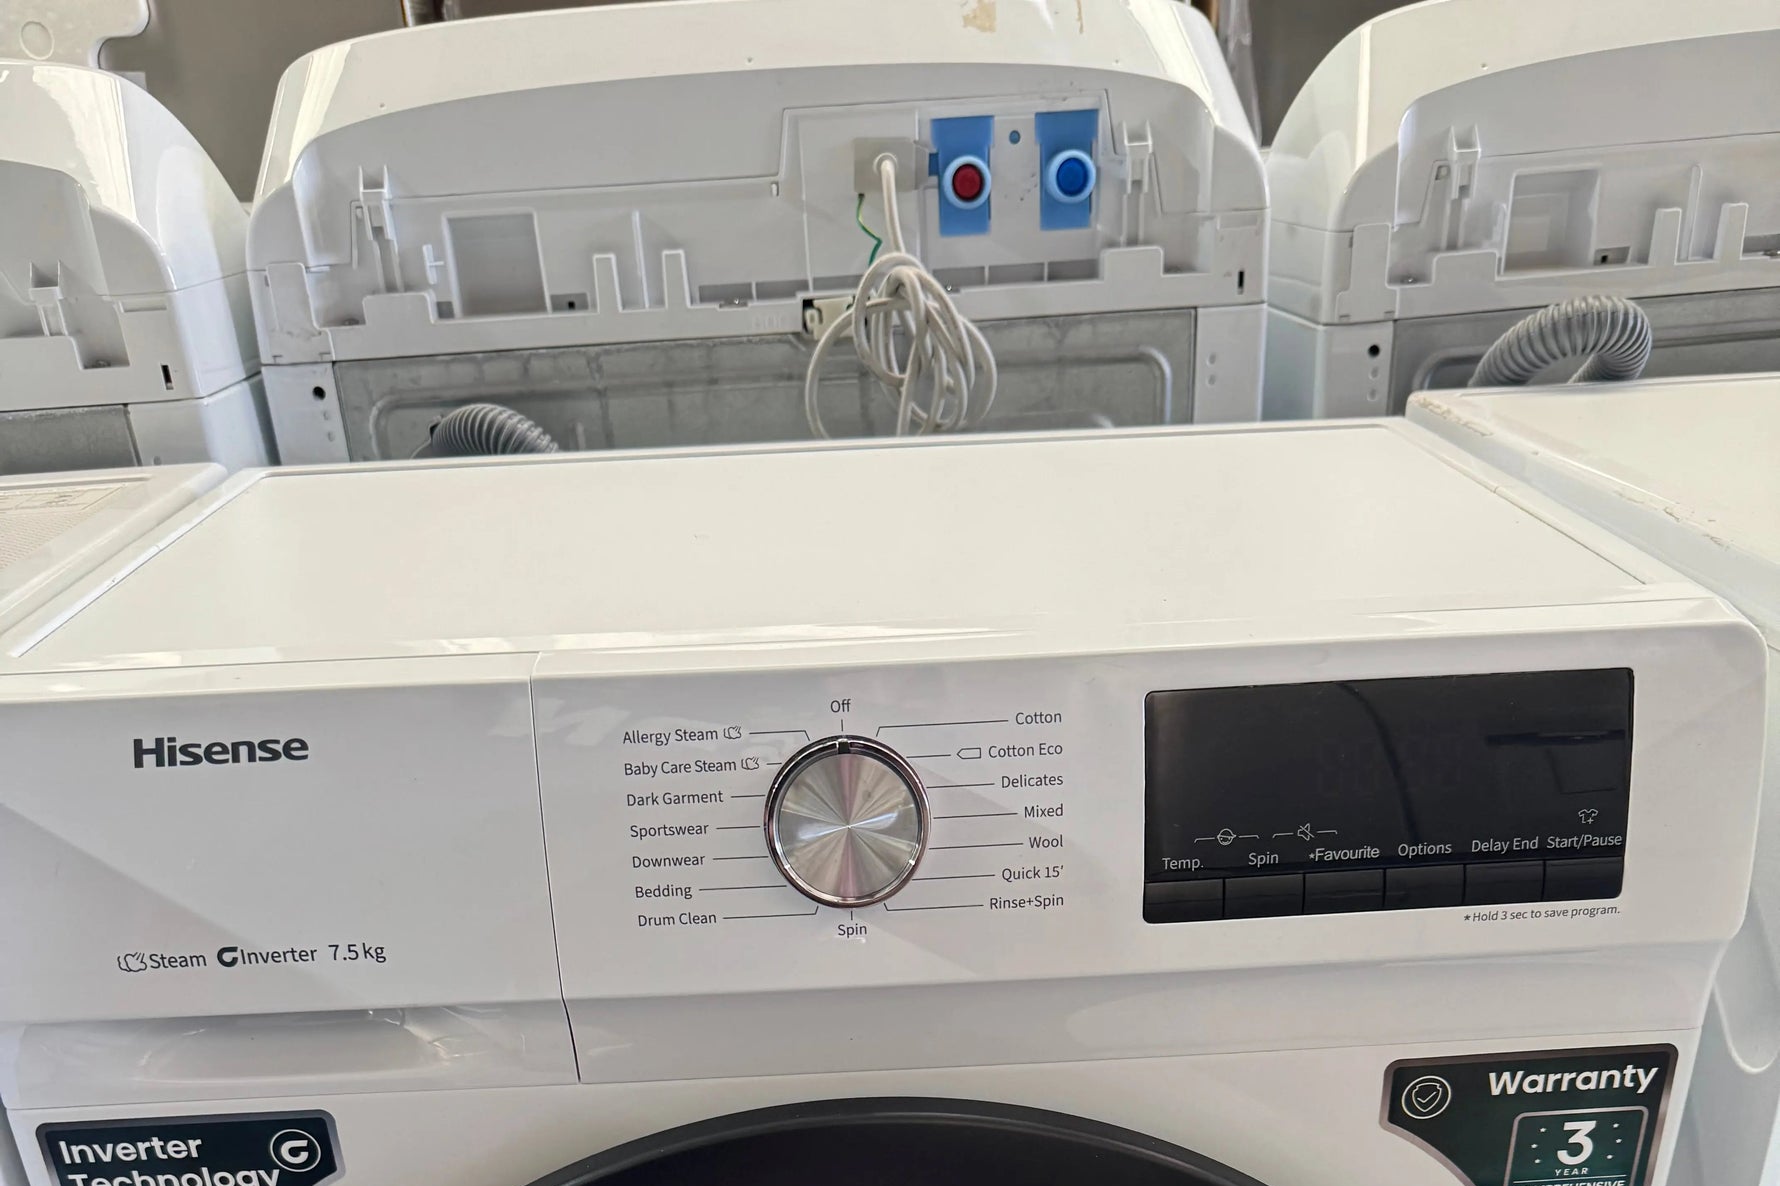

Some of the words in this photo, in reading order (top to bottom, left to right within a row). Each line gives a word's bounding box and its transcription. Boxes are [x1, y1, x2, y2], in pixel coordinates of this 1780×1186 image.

[830, 699, 851, 713] Off
[1015, 711, 1062, 725] Cotton
[623, 729, 671, 745] Allergy
[675, 728, 718, 742] Steam
[134, 737, 309, 769] Hisense
[988, 744, 1035, 758] Cotton
[1038, 743, 1063, 757] Eco
[624, 761, 658, 777] Baby
[661, 760, 692, 774] Care
[695, 758, 736, 772] Steam
[1001, 773, 1063, 788] Delicates
[626, 793, 660, 807] Dark
[663, 790, 723, 805] Garment
[1024, 804, 1063, 818] Mixed
[630, 823, 709, 840] Sportswear
[1029, 835, 1063, 849] Wool
[1471, 837, 1508, 855] Delay
[1512, 835, 1538, 850] End
[1547, 832, 1622, 849] Start/Pause
[1248, 850, 1279, 867] Spin
[1398, 841, 1452, 860] Options
[632, 854, 706, 868] Downwear
[1162, 856, 1204, 872] Temp.
[1001, 866, 1040, 881] Quick
[635, 883, 692, 900] Bedding
[989, 894, 1064, 911] Rinse+Spin
[638, 913, 675, 927] Drum
[679, 911, 717, 925] Clean
[1501, 911, 1508, 920] 3
[1510, 912, 1527, 920] sec
[1530, 910, 1541, 918] to
[1571, 906, 1620, 918] program.
[838, 923, 867, 938] Spin
[150, 952, 207, 969] Steam
[1488, 1064, 1659, 1096] Warranty
[58, 1136, 202, 1165] Inverter
[1557, 1120, 1596, 1166] 3
[1554, 1168, 1590, 1176] YEAR
